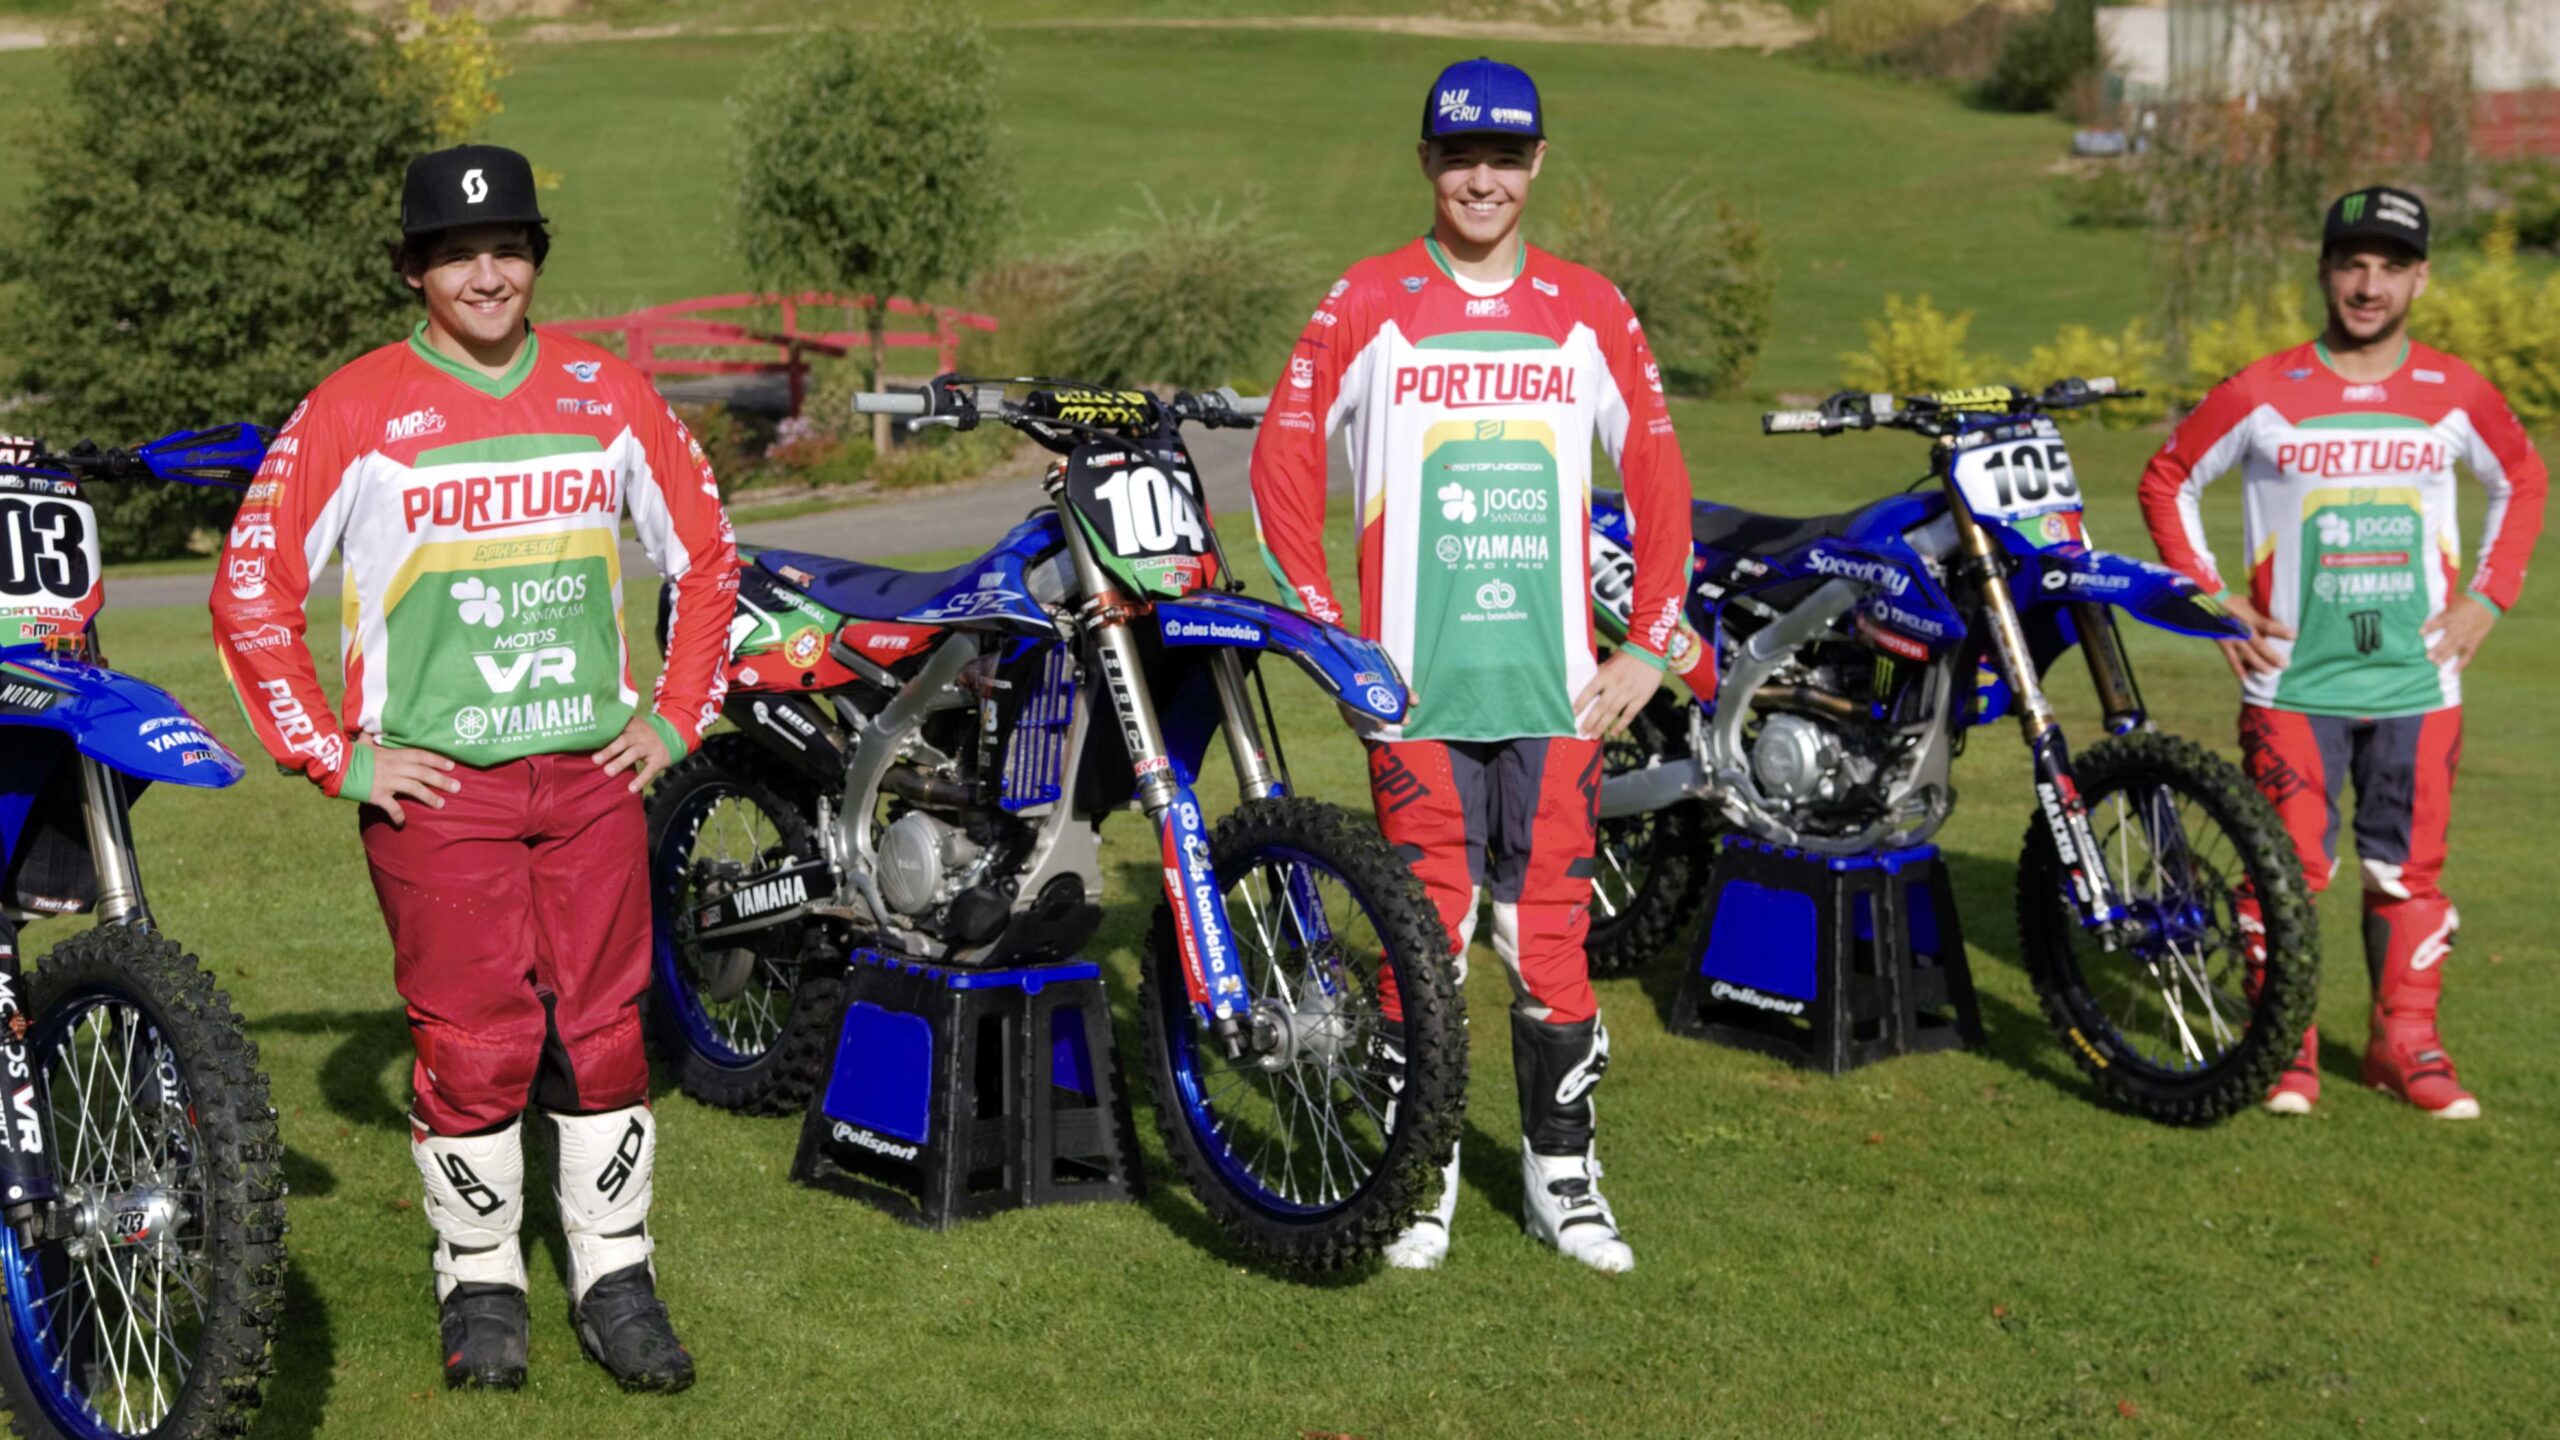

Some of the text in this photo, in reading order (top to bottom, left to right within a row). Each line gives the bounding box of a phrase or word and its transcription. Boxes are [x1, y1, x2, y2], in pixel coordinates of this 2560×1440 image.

[1394, 363, 1577, 410] PORTUGAL
[1984, 445, 2077, 507] 105
[2277, 440, 2445, 478] PORTUGAL
[403, 469, 617, 534] PORTUGAL
[1094, 466, 1205, 556] 104
[1482, 487, 1548, 518] JOGOS
[230, 524, 277, 550] VR
[1463, 534, 1550, 562] YAMAHA
[512, 574, 588, 618] JOGOS
[494, 628, 558, 650] MOTOS
[473, 646, 577, 694] VR
[491, 694, 596, 737] YAMAHA
[2037, 783, 2078, 865] MAXXIS
[732, 875, 808, 919] YAMAHA
[1195, 885, 1226, 973] bandeira
[1711, 979, 1805, 1016] Polisport
[832, 1121, 919, 1162] Polisport
